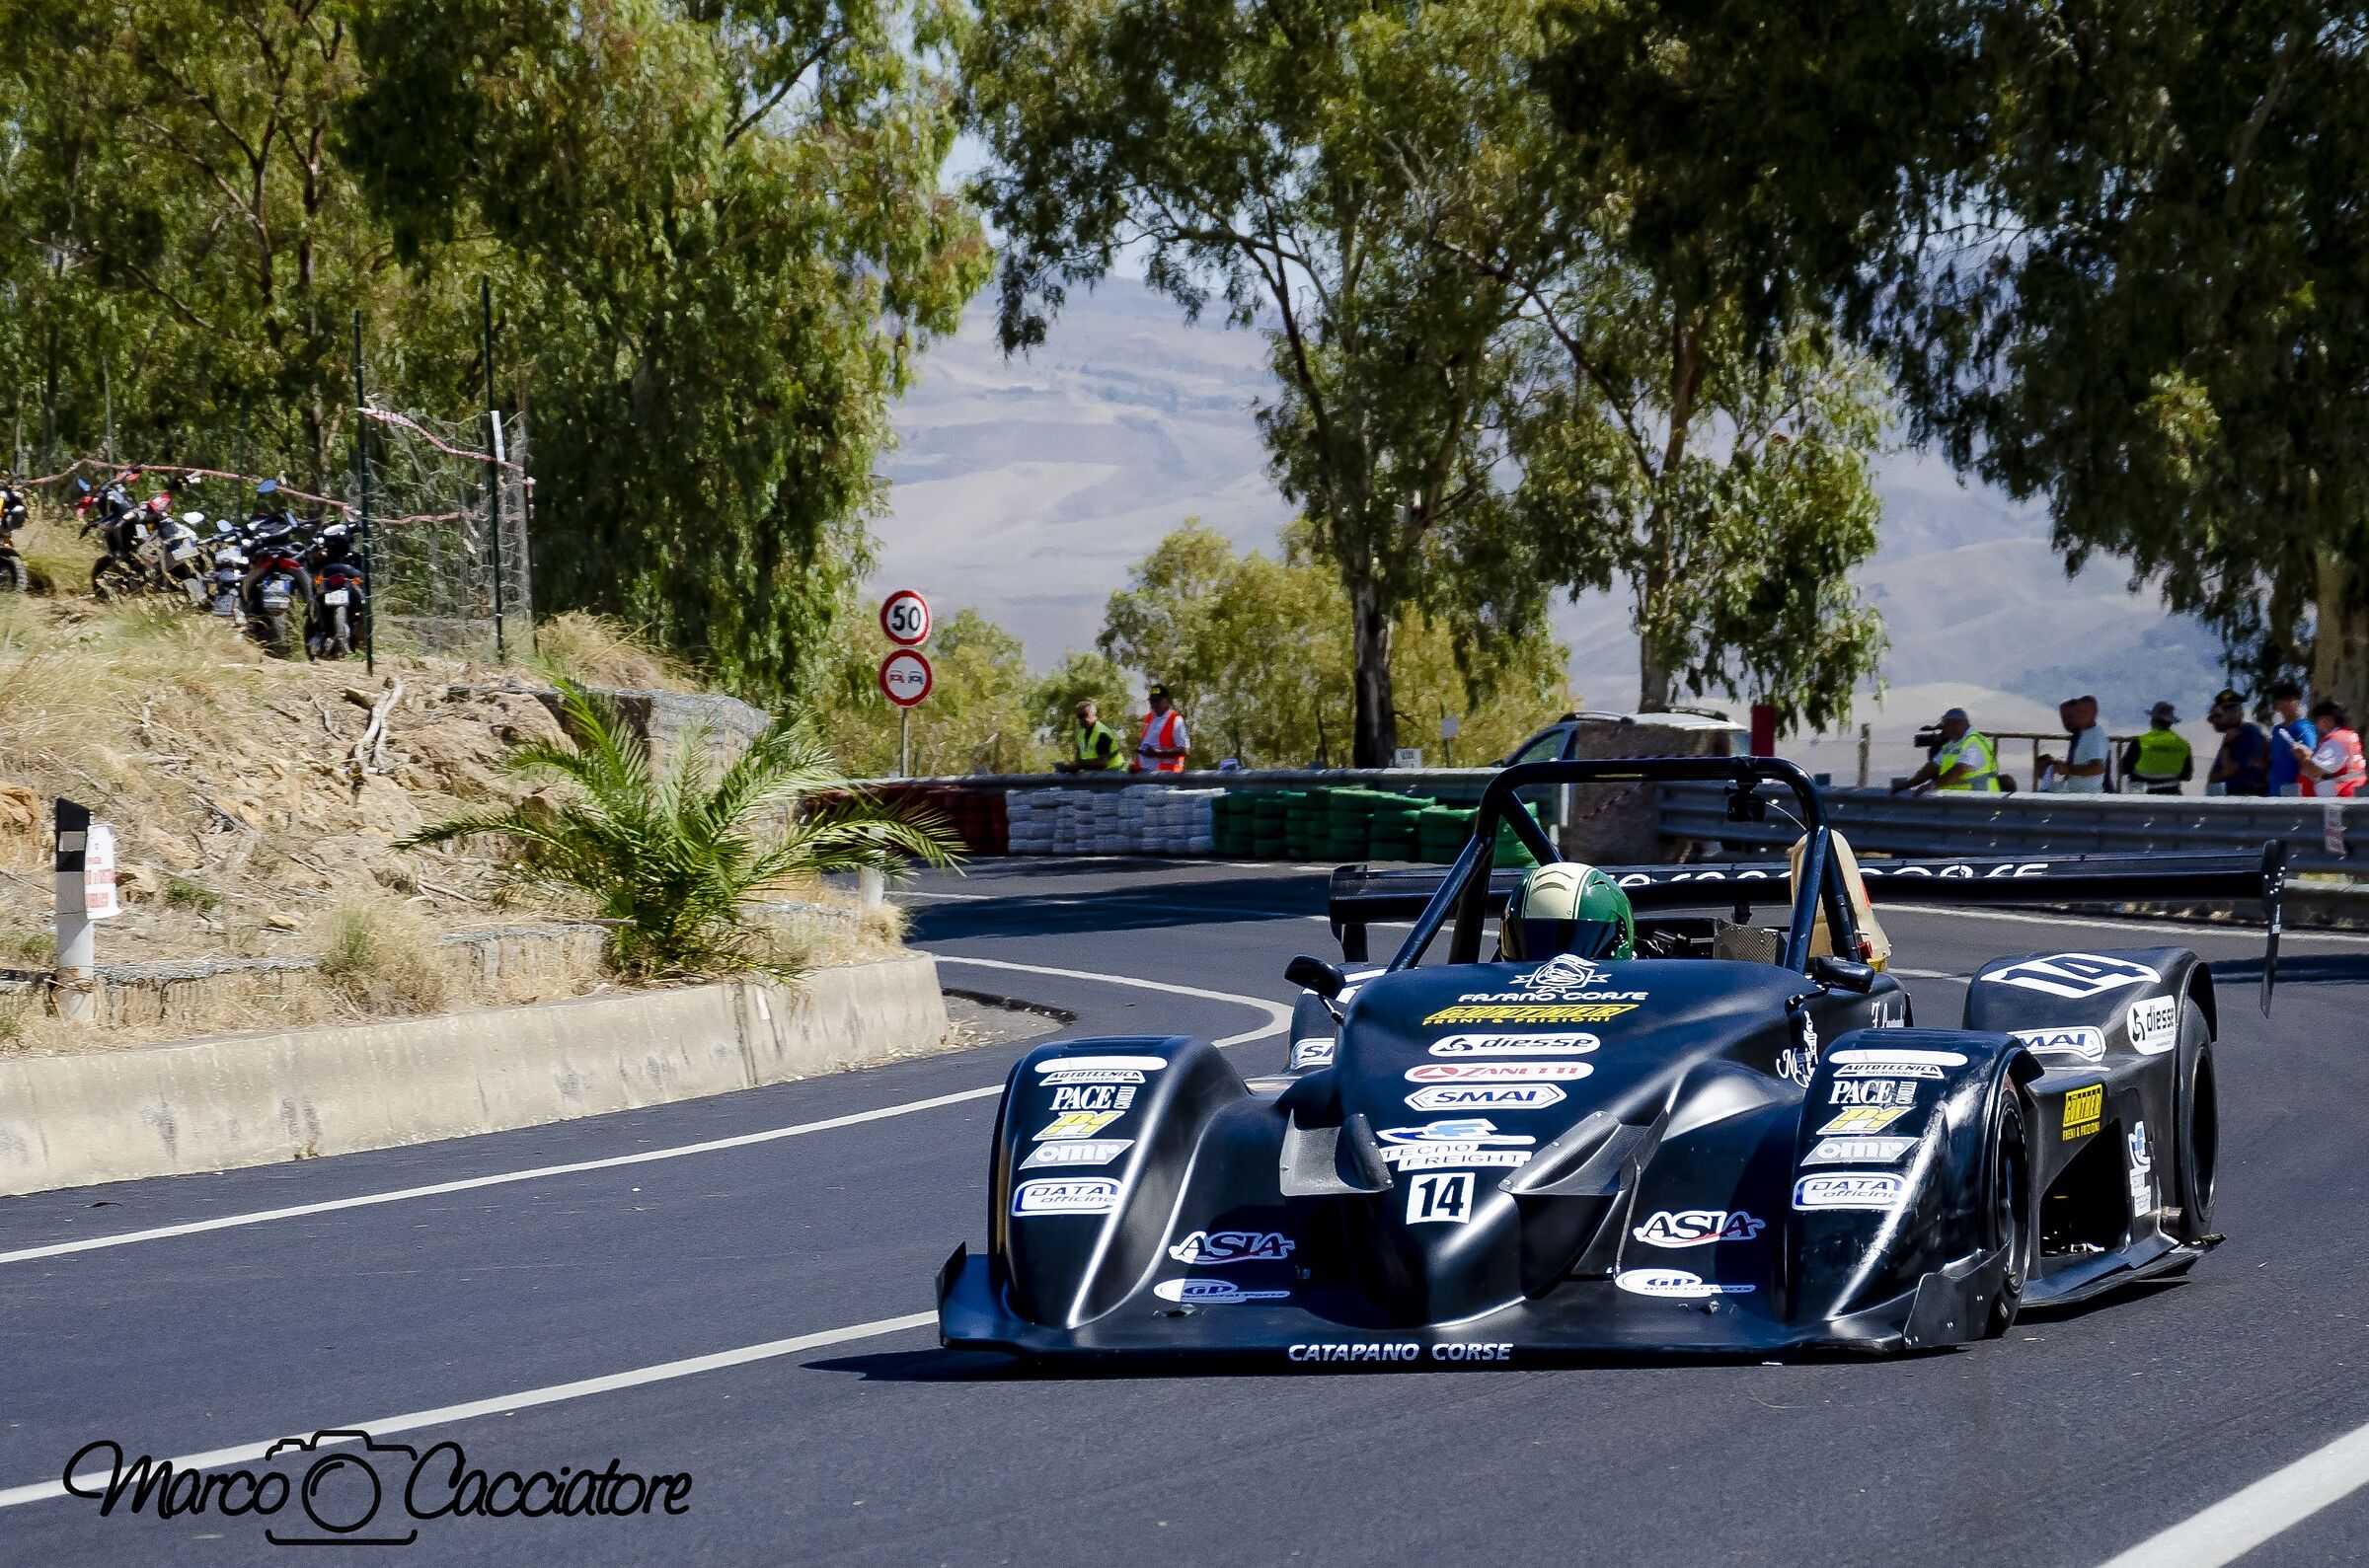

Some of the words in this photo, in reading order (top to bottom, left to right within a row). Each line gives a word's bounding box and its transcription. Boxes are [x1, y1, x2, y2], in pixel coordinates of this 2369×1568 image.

[891, 605, 922, 632] 50
[2001, 956, 2150, 992] 14
[1458, 992, 1557, 1003] FASANO
[1563, 992, 1649, 1002] CORSE
[1433, 1005, 1629, 1018] GUNTHER
[1480, 1037, 1593, 1048] diesse
[2022, 1033, 2086, 1048] MAI
[1457, 1067, 1579, 1078] ZANETTI
[1843, 1064, 1939, 1073] AUTOTECNICA
[1050, 1071, 1140, 1080] AUTOTECNICA
[1049, 1085, 1116, 1111] PACE
[1434, 1090, 1538, 1103] SMAI
[1828, 1081, 1896, 1105] PACE
[1406, 1154, 1521, 1166] FREIGHT
[1030, 1185, 1105, 1197] DATA
[1811, 1180, 1889, 1191] DATA
[1418, 1176, 1467, 1218] 14
[1643, 1214, 1753, 1240] ASIA
[1178, 1233, 1285, 1259] ASIA
[1288, 1343, 1420, 1361] CATAPANO
[1432, 1343, 1514, 1361] CORSE
